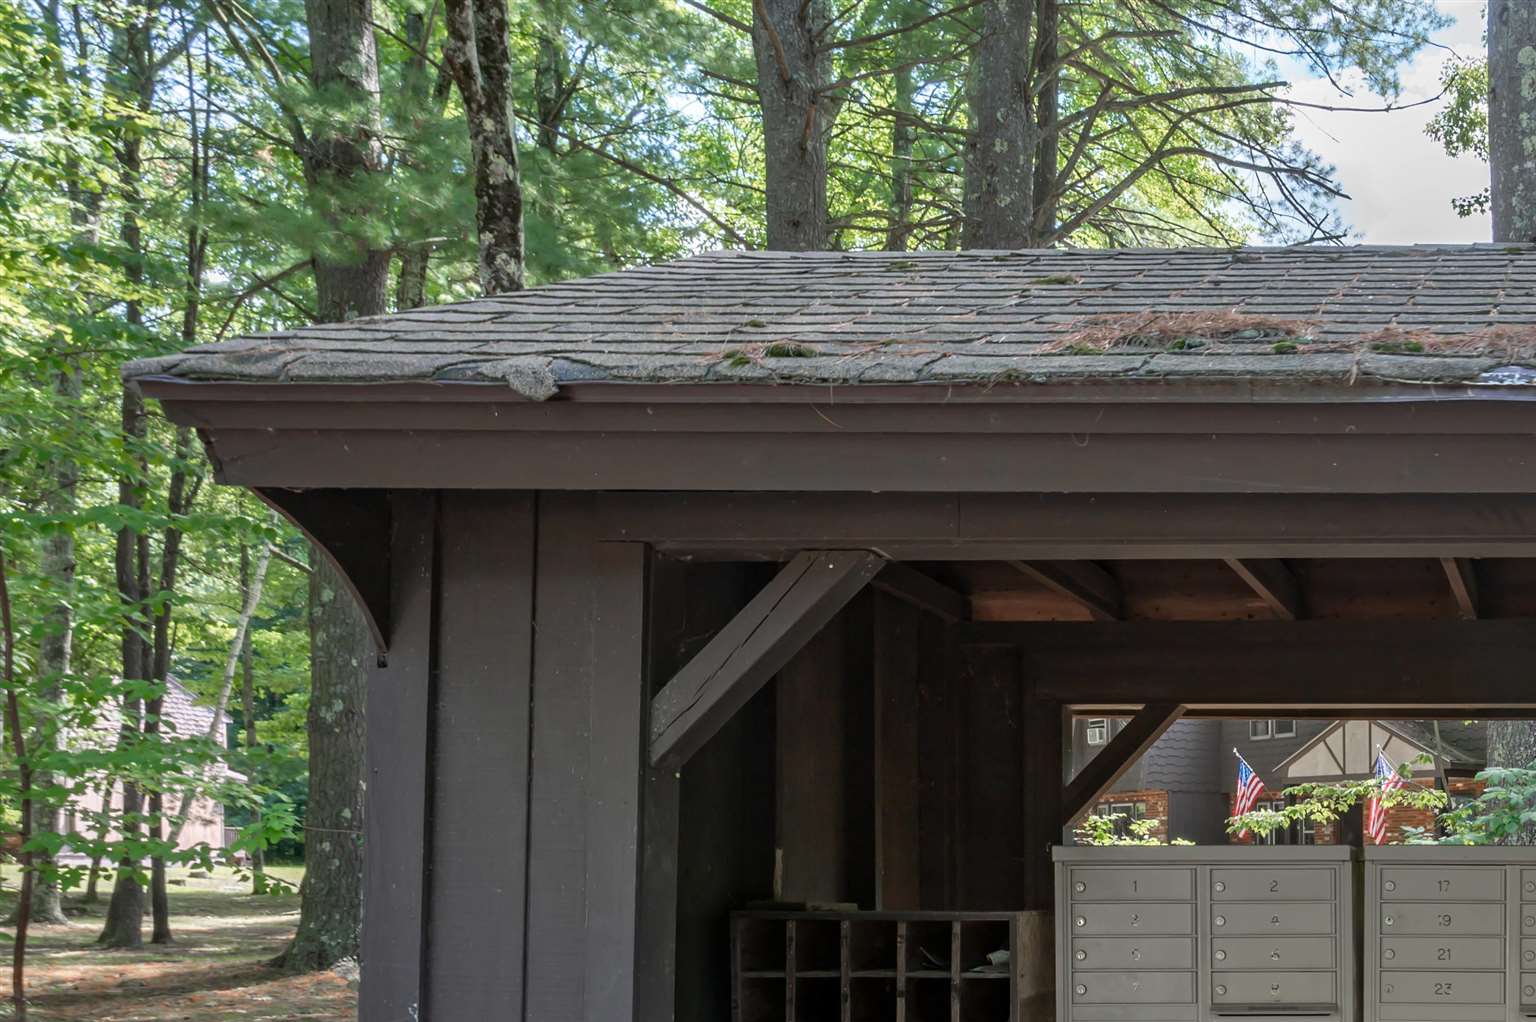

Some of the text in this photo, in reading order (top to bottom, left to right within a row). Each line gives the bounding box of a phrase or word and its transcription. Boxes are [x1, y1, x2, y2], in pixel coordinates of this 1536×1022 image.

[1132, 880, 1139, 893] 1
[1269, 880, 1279, 893] 2
[1437, 880, 1450, 893] 17
[1437, 948, 1451, 960] 21
[1434, 983, 1452, 996] 23
